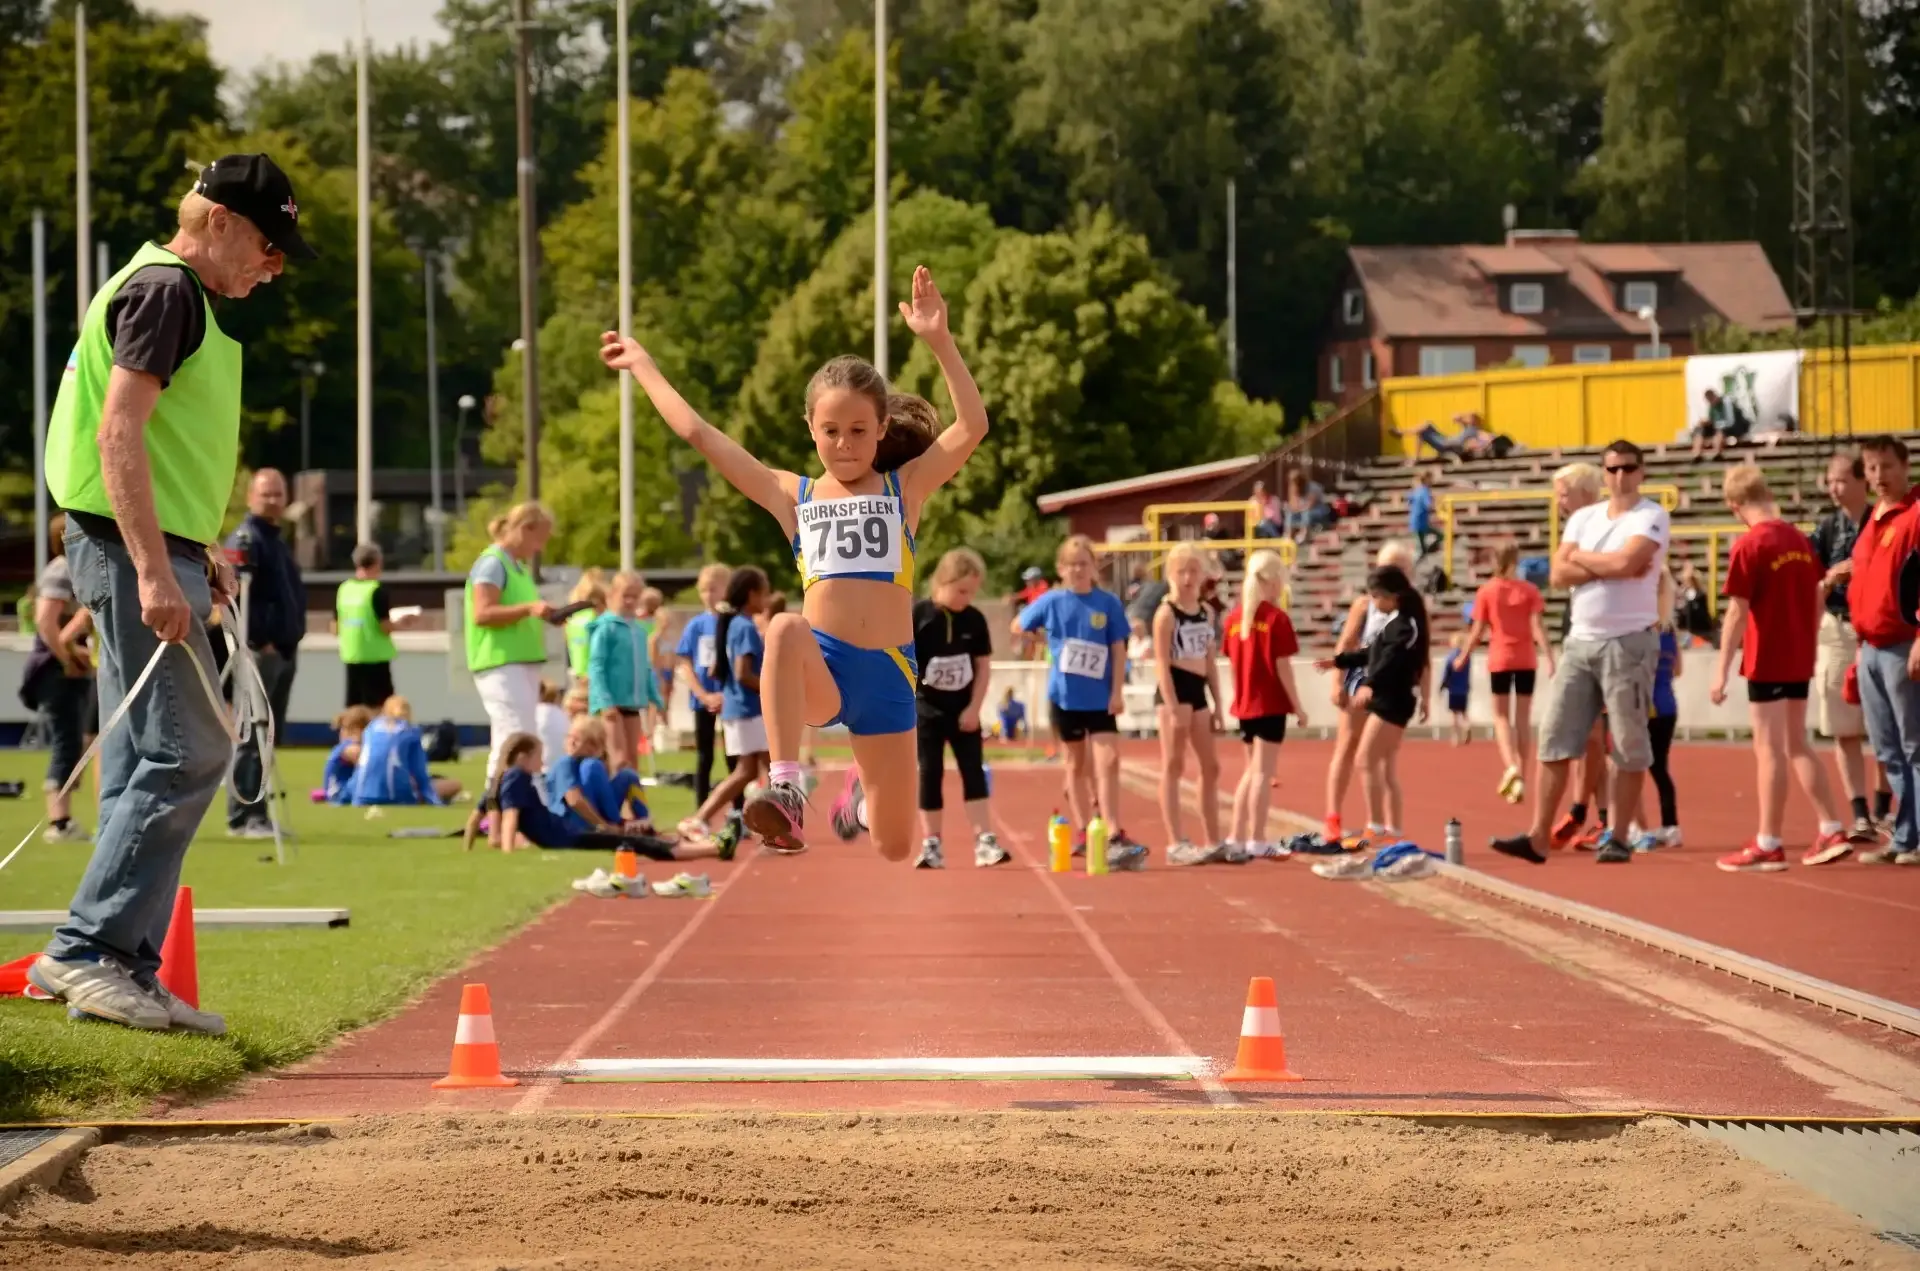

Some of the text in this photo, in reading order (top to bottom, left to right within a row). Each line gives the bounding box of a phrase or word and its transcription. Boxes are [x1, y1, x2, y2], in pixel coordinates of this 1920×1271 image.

[802, 500, 894, 523] GURKSPELEN
[809, 516, 889, 562] 759
[1068, 649, 1101, 672] 712
